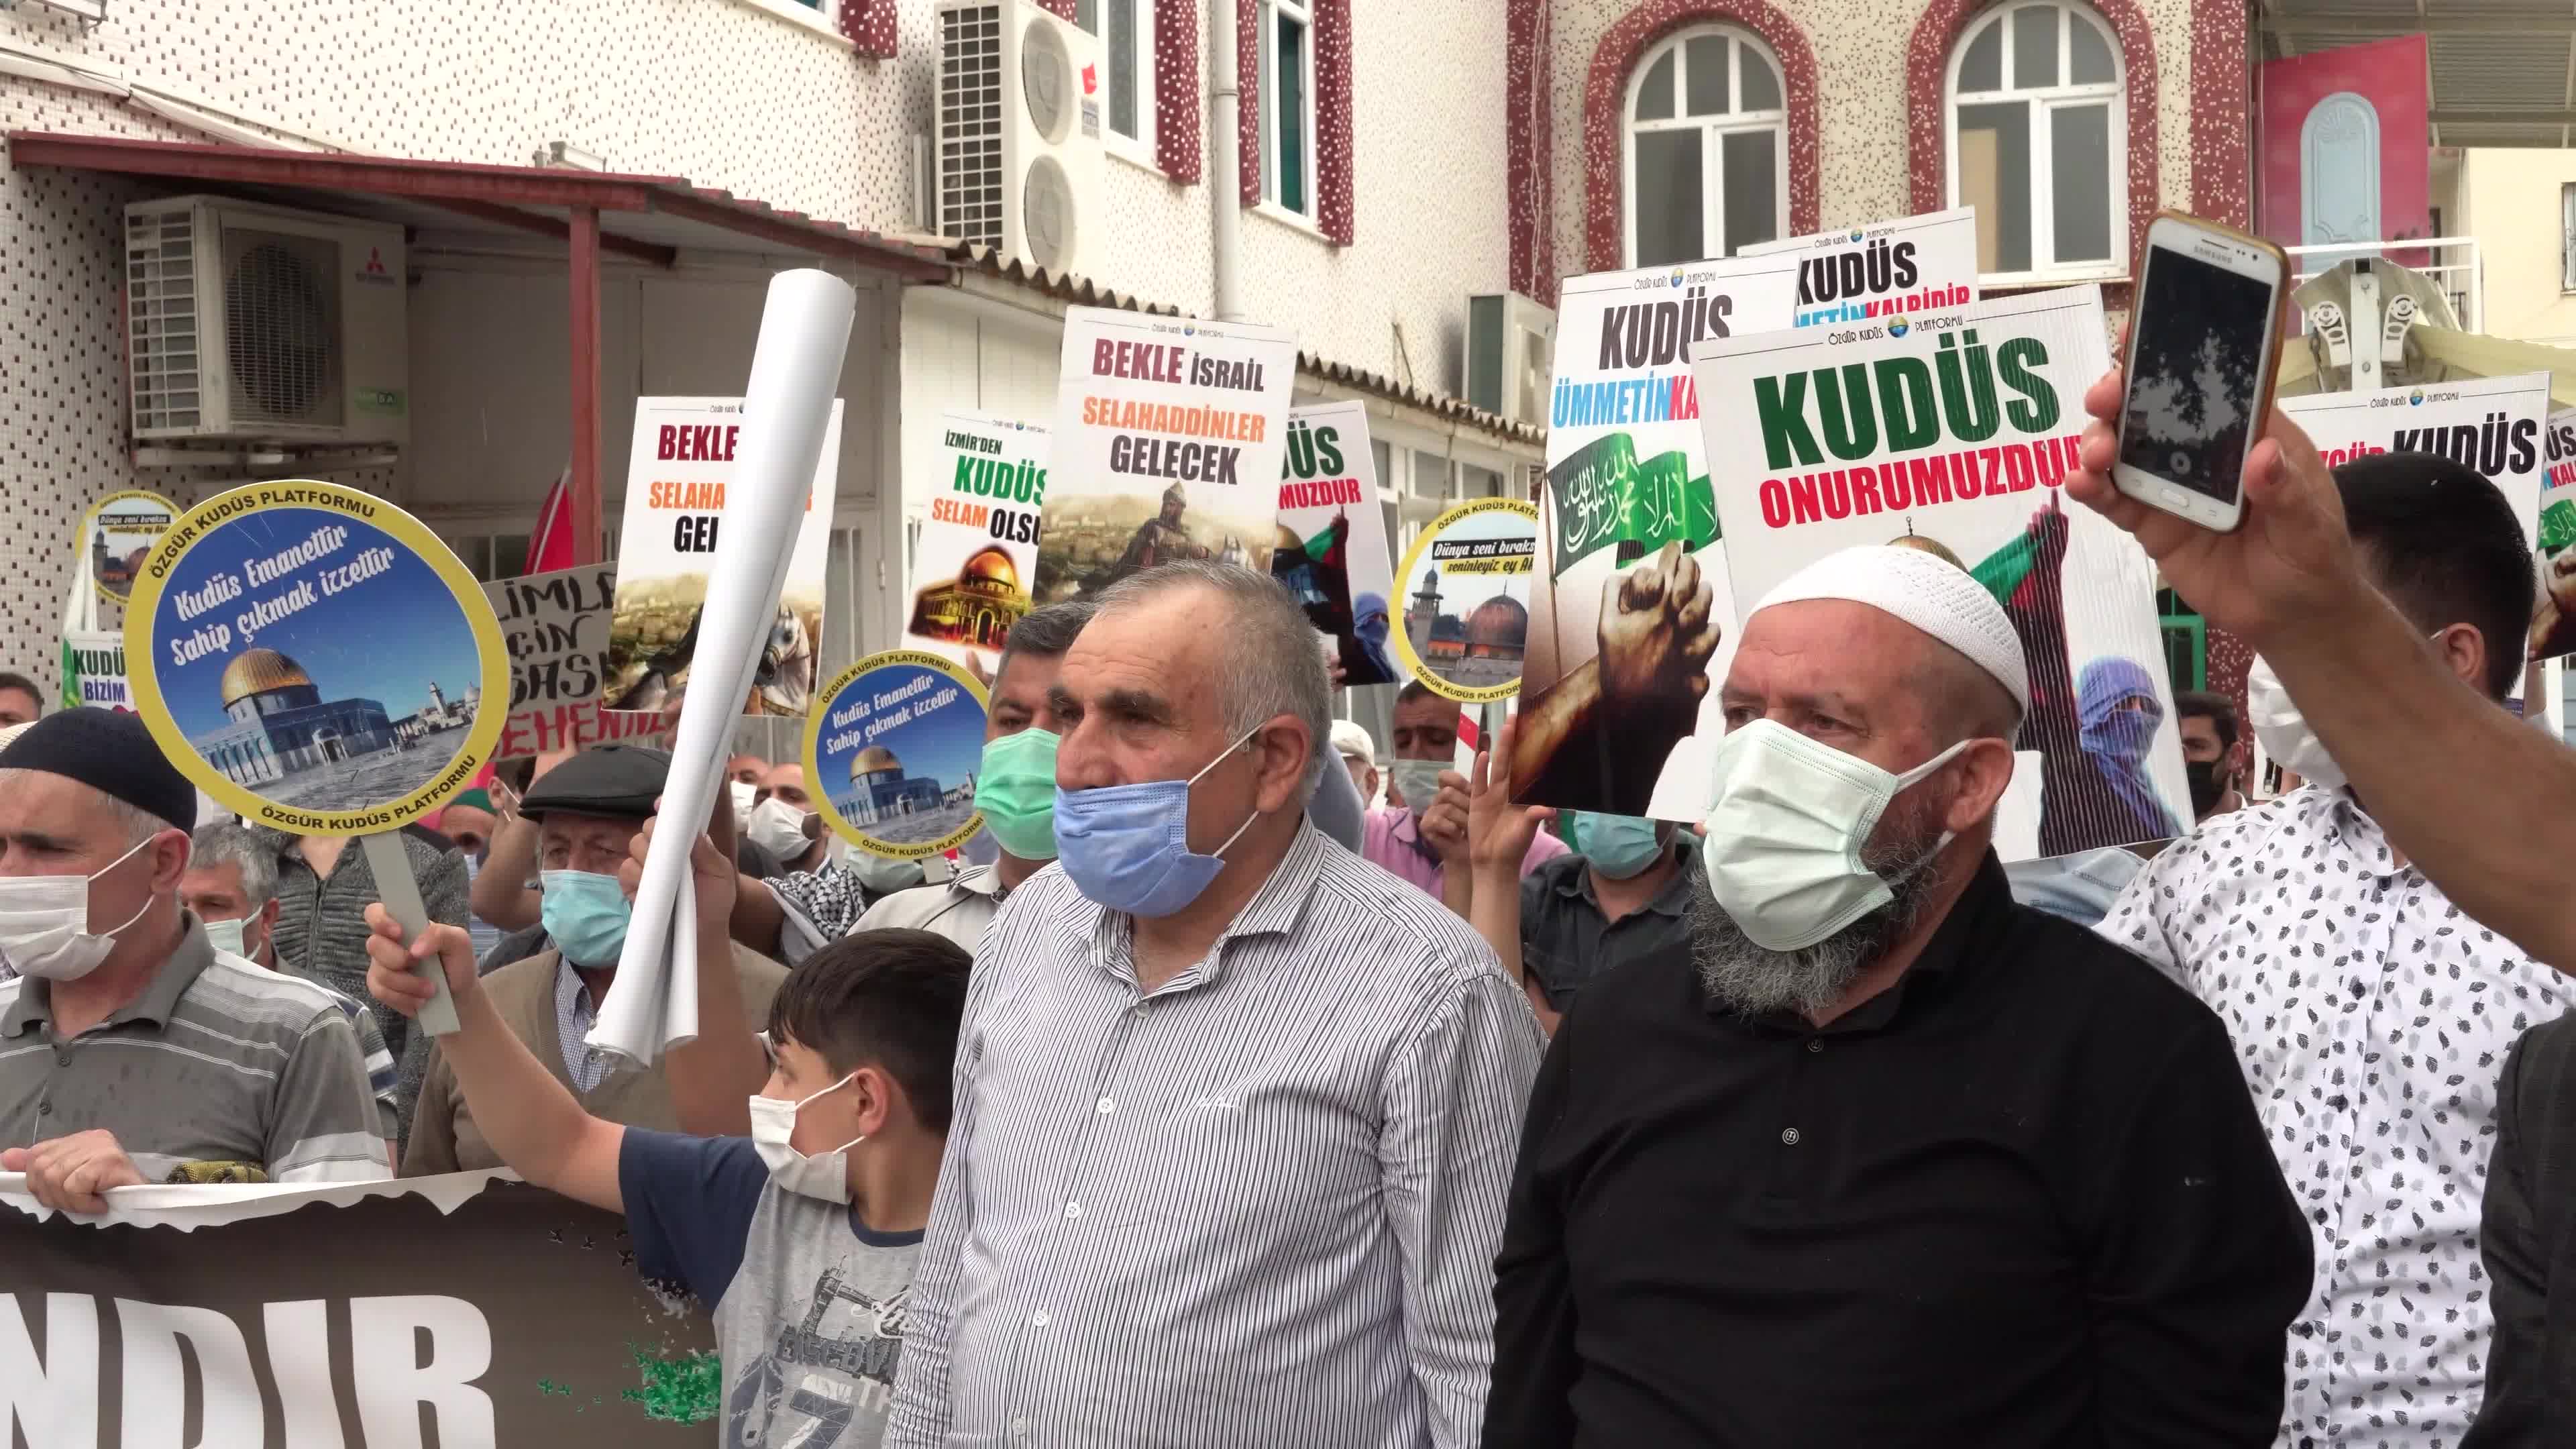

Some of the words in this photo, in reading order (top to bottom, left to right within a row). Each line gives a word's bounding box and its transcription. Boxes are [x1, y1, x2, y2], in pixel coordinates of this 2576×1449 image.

[1796, 239, 1918, 307] KUDÜS
[1828, 331, 1857, 346] ÖZGÜR
[1859, 327, 1884, 342] KUDÜS
[1915, 315, 1964, 332] PLATFORMU
[1093, 337, 1185, 384] BEKLE
[1189, 351, 1264, 392] İSRAİL
[1753, 328, 2061, 472] KUDÜS
[1083, 396, 1266, 443] SELAHADDİNLER
[657, 424, 740, 462] BEKLE
[944, 429, 1003, 455] İZMİR'DEN
[1110, 435, 1240, 485] GELECEK
[649, 481, 725, 510] SELAHA
[932, 497, 989, 529] SELAM
[1279, 478, 1362, 510] MUZDUR
[1472, 502, 1505, 513] KUDÜS
[149, 527, 198, 580] ÖZGÜR
[196, 496, 257, 533] KUDÜS
[260, 490, 376, 519] PLATFORMU
[1434, 542, 1470, 559] Dünya
[1472, 542, 1497, 555] seni
[1499, 539, 1536, 553] bıraks
[172, 572, 243, 623] Kudüs
[243, 524, 348, 589] Emanettir
[1448, 559, 1500, 575] seninleyiz
[1503, 561, 1519, 575] ey
[171, 622, 232, 666] Sahip
[236, 579, 318, 643] çıkmak
[321, 546, 396, 597] izzettir
[506, 614, 594, 661] ÇİN
[72, 646, 126, 676] KUDÜ
[851, 655, 885, 678] KUDÜS
[888, 654, 951, 672] PLATFORMU
[84, 678, 126, 702] BİZİM
[832, 700, 870, 730] Kudüs
[873, 674, 934, 711] Emanettir
[1444, 685, 1475, 699] KUDÜS
[1477, 683, 1523, 700] PLATFOR
[826, 729, 861, 756] Sahip
[865, 707, 912, 743] çıkmak
[260, 804, 324, 830] ÖZGÜR
[329, 812, 392, 830] KUDÜS
[393, 755, 478, 821] PLATFORMU
